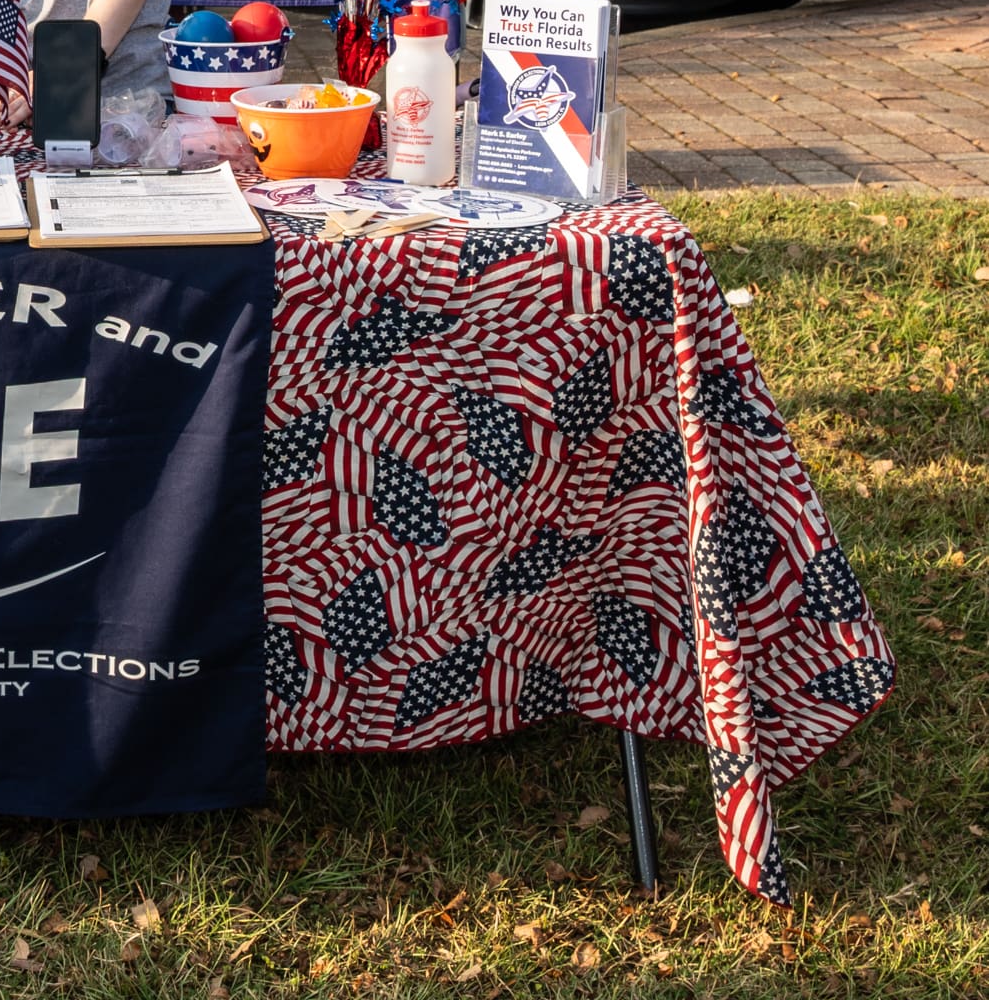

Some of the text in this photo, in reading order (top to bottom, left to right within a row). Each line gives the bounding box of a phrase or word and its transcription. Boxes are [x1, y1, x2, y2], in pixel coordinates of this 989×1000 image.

[500, 4, 585, 22] Why You Can
[500, 19, 583, 37] Trust Florida
[488, 32, 593, 52] Election Results
[480, 128, 499, 137] Mark
[94, 313, 219, 370] and
